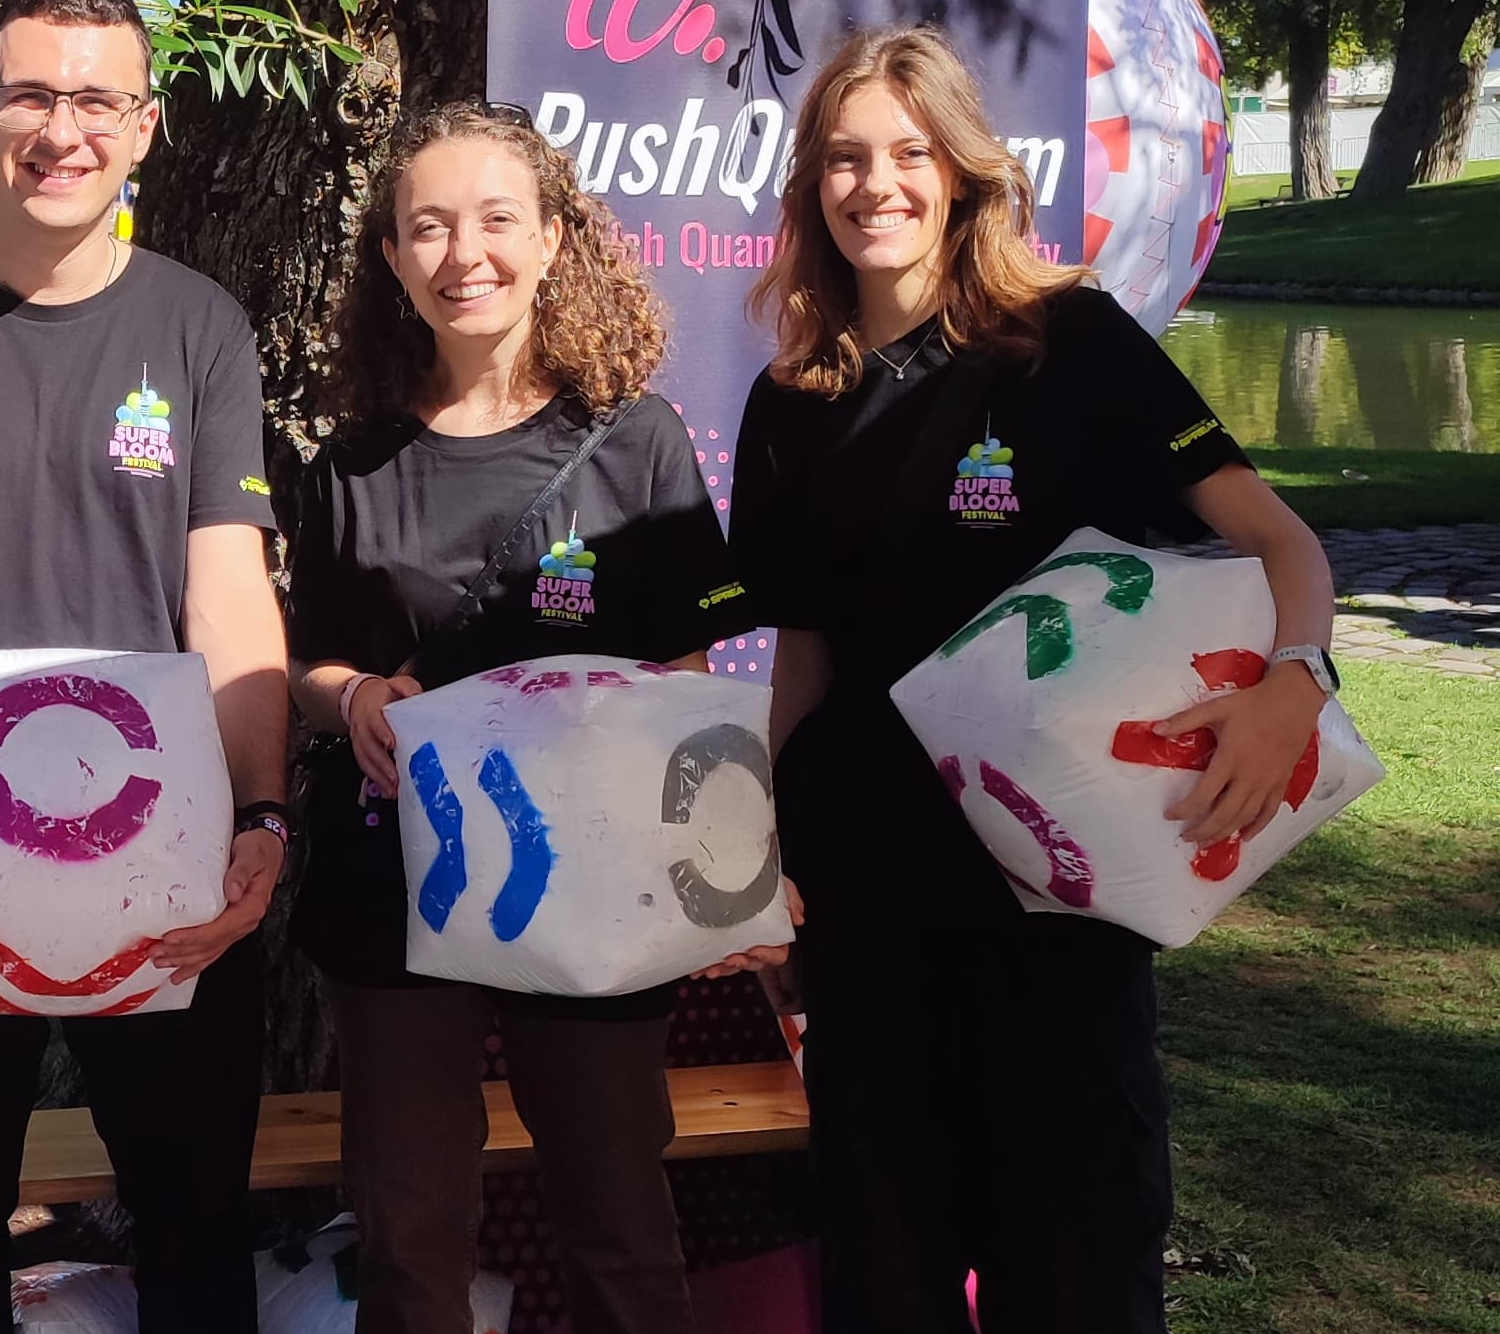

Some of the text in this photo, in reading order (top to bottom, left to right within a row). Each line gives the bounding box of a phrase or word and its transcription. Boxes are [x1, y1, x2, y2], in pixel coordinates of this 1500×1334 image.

[533, 91, 1065, 216] PushQm
[680, 221, 774, 275] Quan
[113, 425, 170, 449] SUPER
[954, 478, 1013, 495] SUPER
[961, 511, 1006, 520] FESTIVAL
[536, 576, 592, 598] SUPER
[541, 609, 584, 622] FESTIVAL
